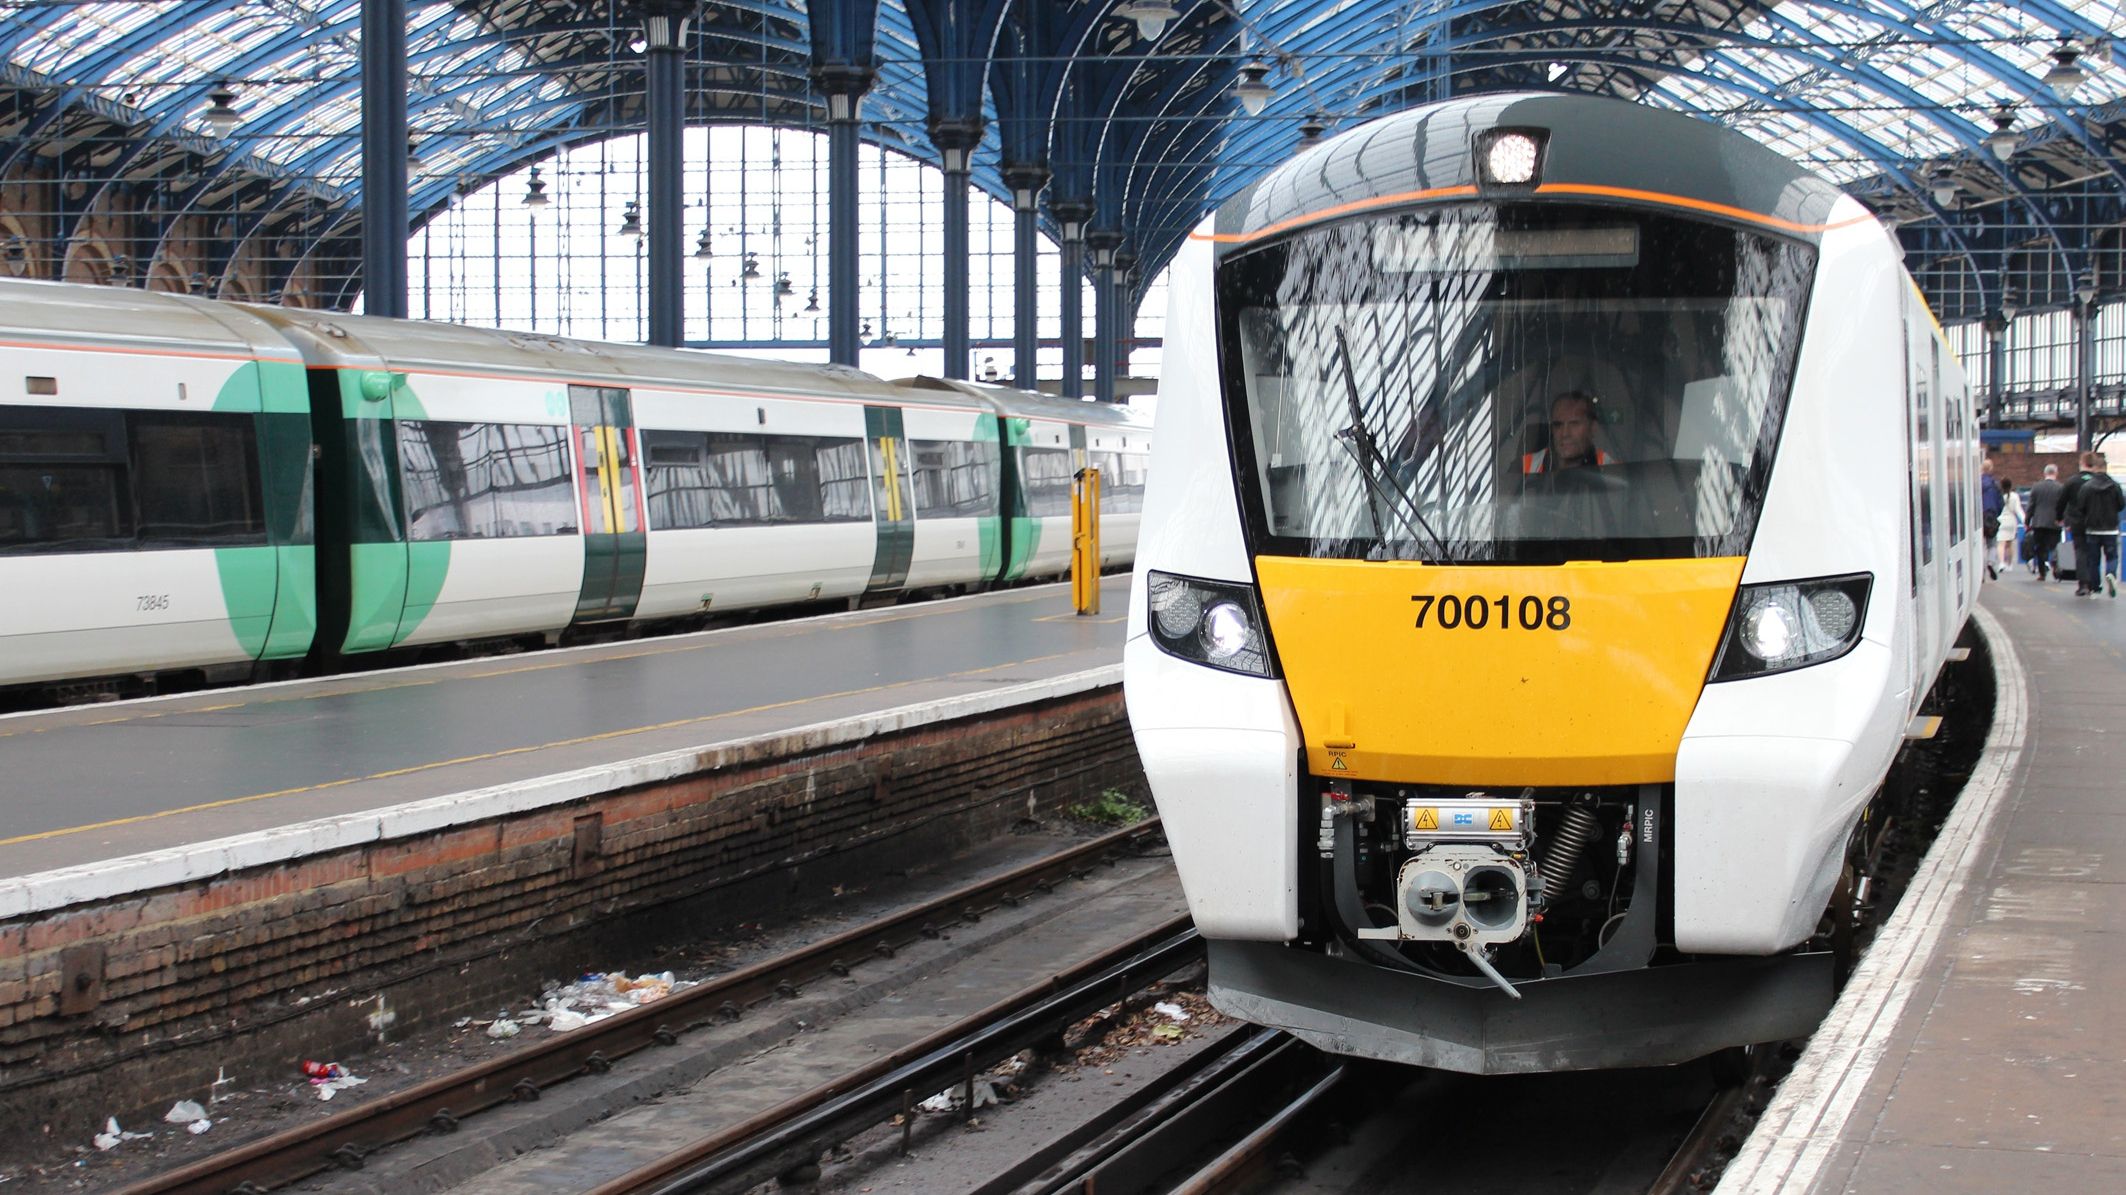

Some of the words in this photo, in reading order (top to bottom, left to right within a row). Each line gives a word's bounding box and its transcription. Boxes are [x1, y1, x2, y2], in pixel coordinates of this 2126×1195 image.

[136, 594, 169, 611] 73845
[1411, 595, 1571, 630] 700108
[1643, 808, 1654, 843] MRPIC
